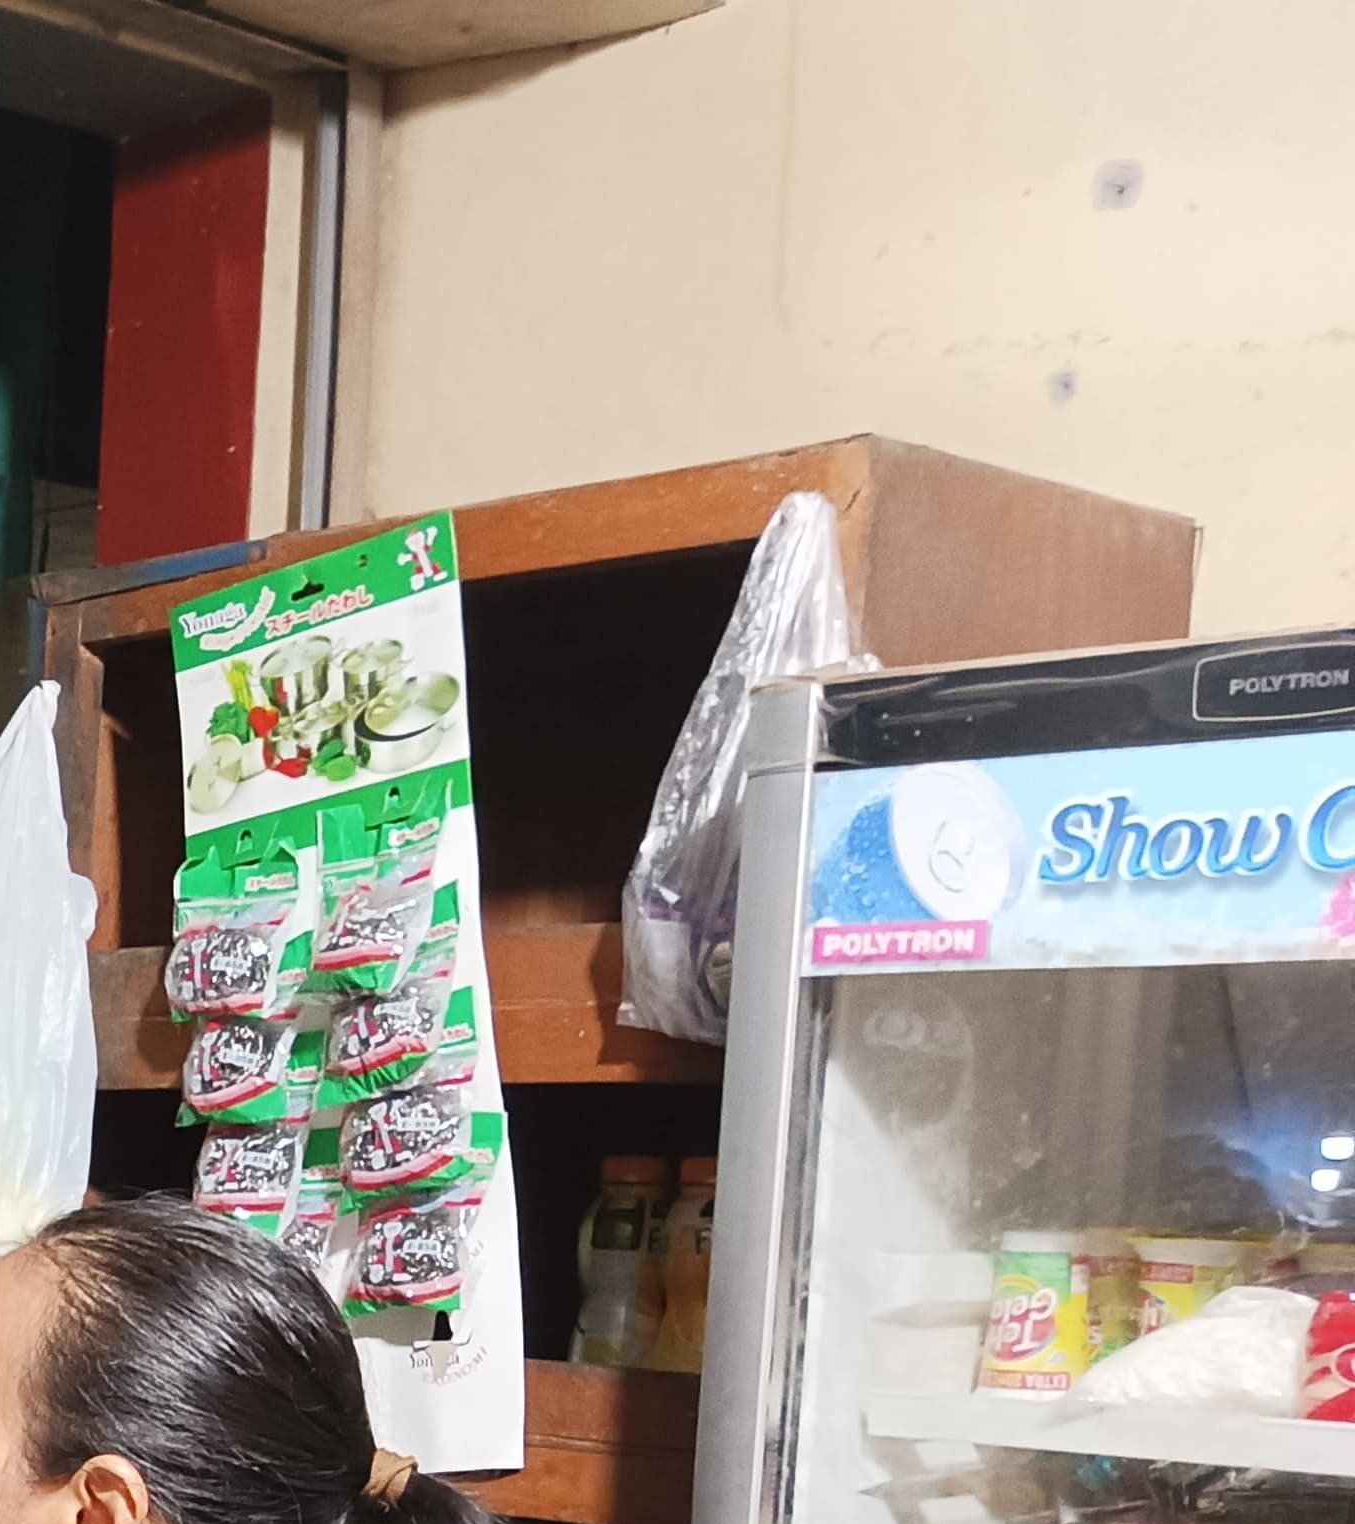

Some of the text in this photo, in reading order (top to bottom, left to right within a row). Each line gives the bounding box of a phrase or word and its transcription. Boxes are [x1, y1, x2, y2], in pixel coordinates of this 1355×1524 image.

[1228, 668, 1351, 697] POLYTRON
[1039, 795, 1292, 884] Show
[822, 928, 975, 958] POLYTRON
